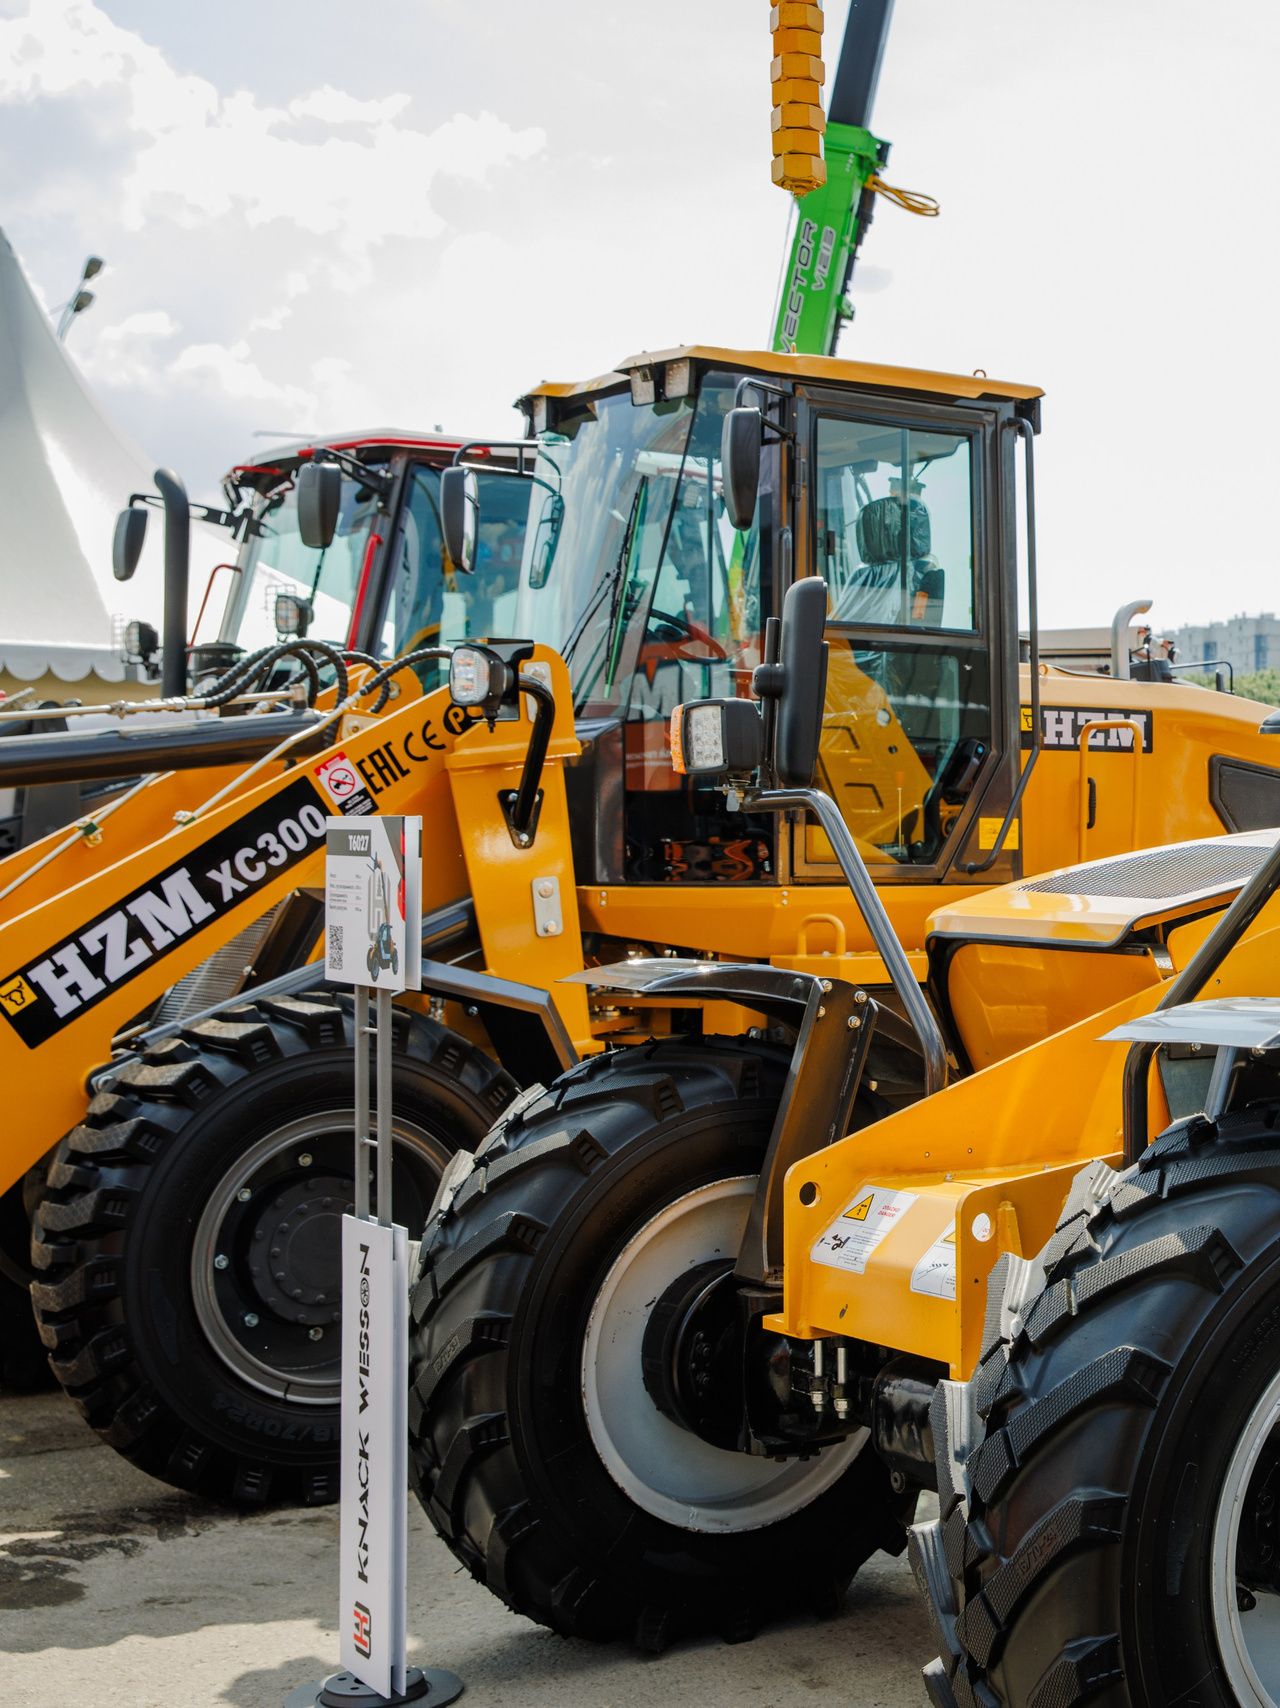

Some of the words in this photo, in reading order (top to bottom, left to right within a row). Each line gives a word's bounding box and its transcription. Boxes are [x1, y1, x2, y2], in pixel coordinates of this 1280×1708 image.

[1043, 710, 1147, 748] HZM
[27, 867, 216, 1019] HZM
[206, 804, 327, 903] XC300
[348, 834, 369, 852] T6027
[358, 1243, 371, 1415] WESSON
[357, 1427, 371, 1584] KNACK
